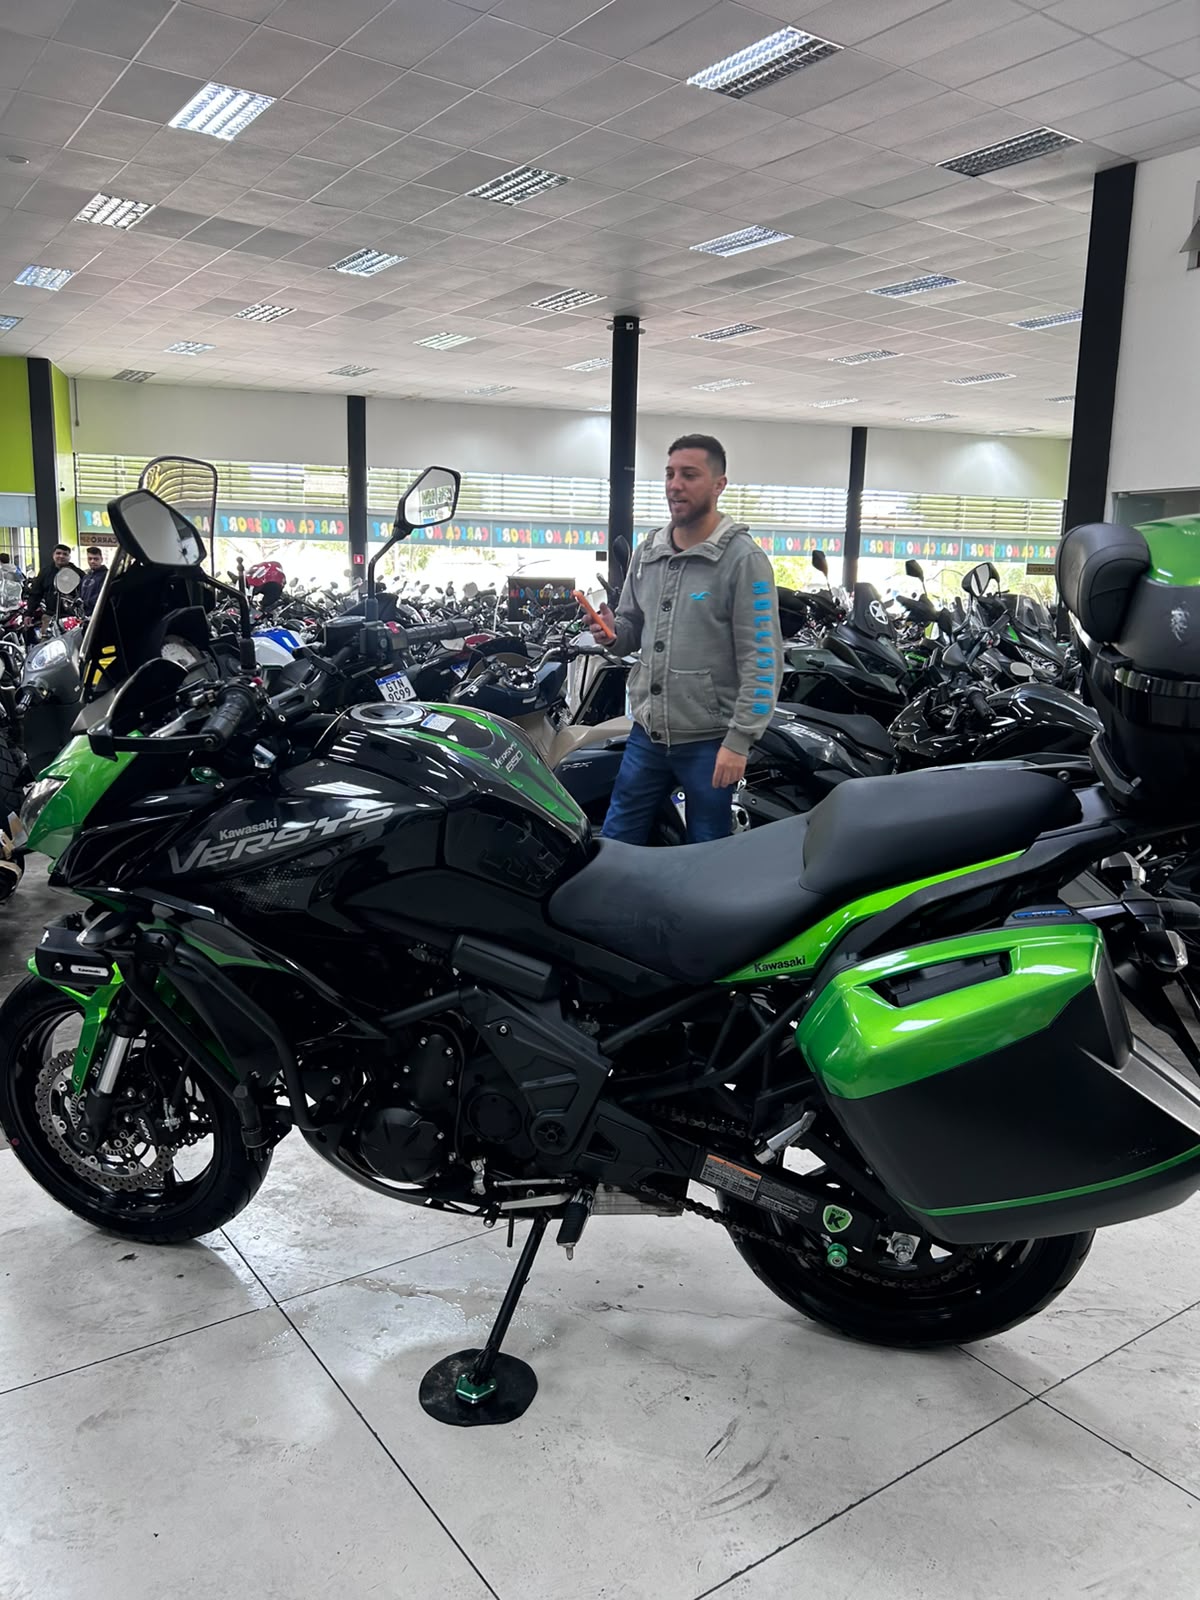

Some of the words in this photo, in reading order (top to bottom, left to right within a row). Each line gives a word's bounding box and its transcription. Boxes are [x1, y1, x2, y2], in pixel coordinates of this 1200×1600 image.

[752, 581, 775, 715] HOLLISTER
[490, 740, 518, 770] VERSYS
[505, 750, 524, 773] 650
[167, 801, 397, 875] VERSYS
[219, 817, 278, 841] Kawasaki
[753, 954, 806, 973] Kawasaki
